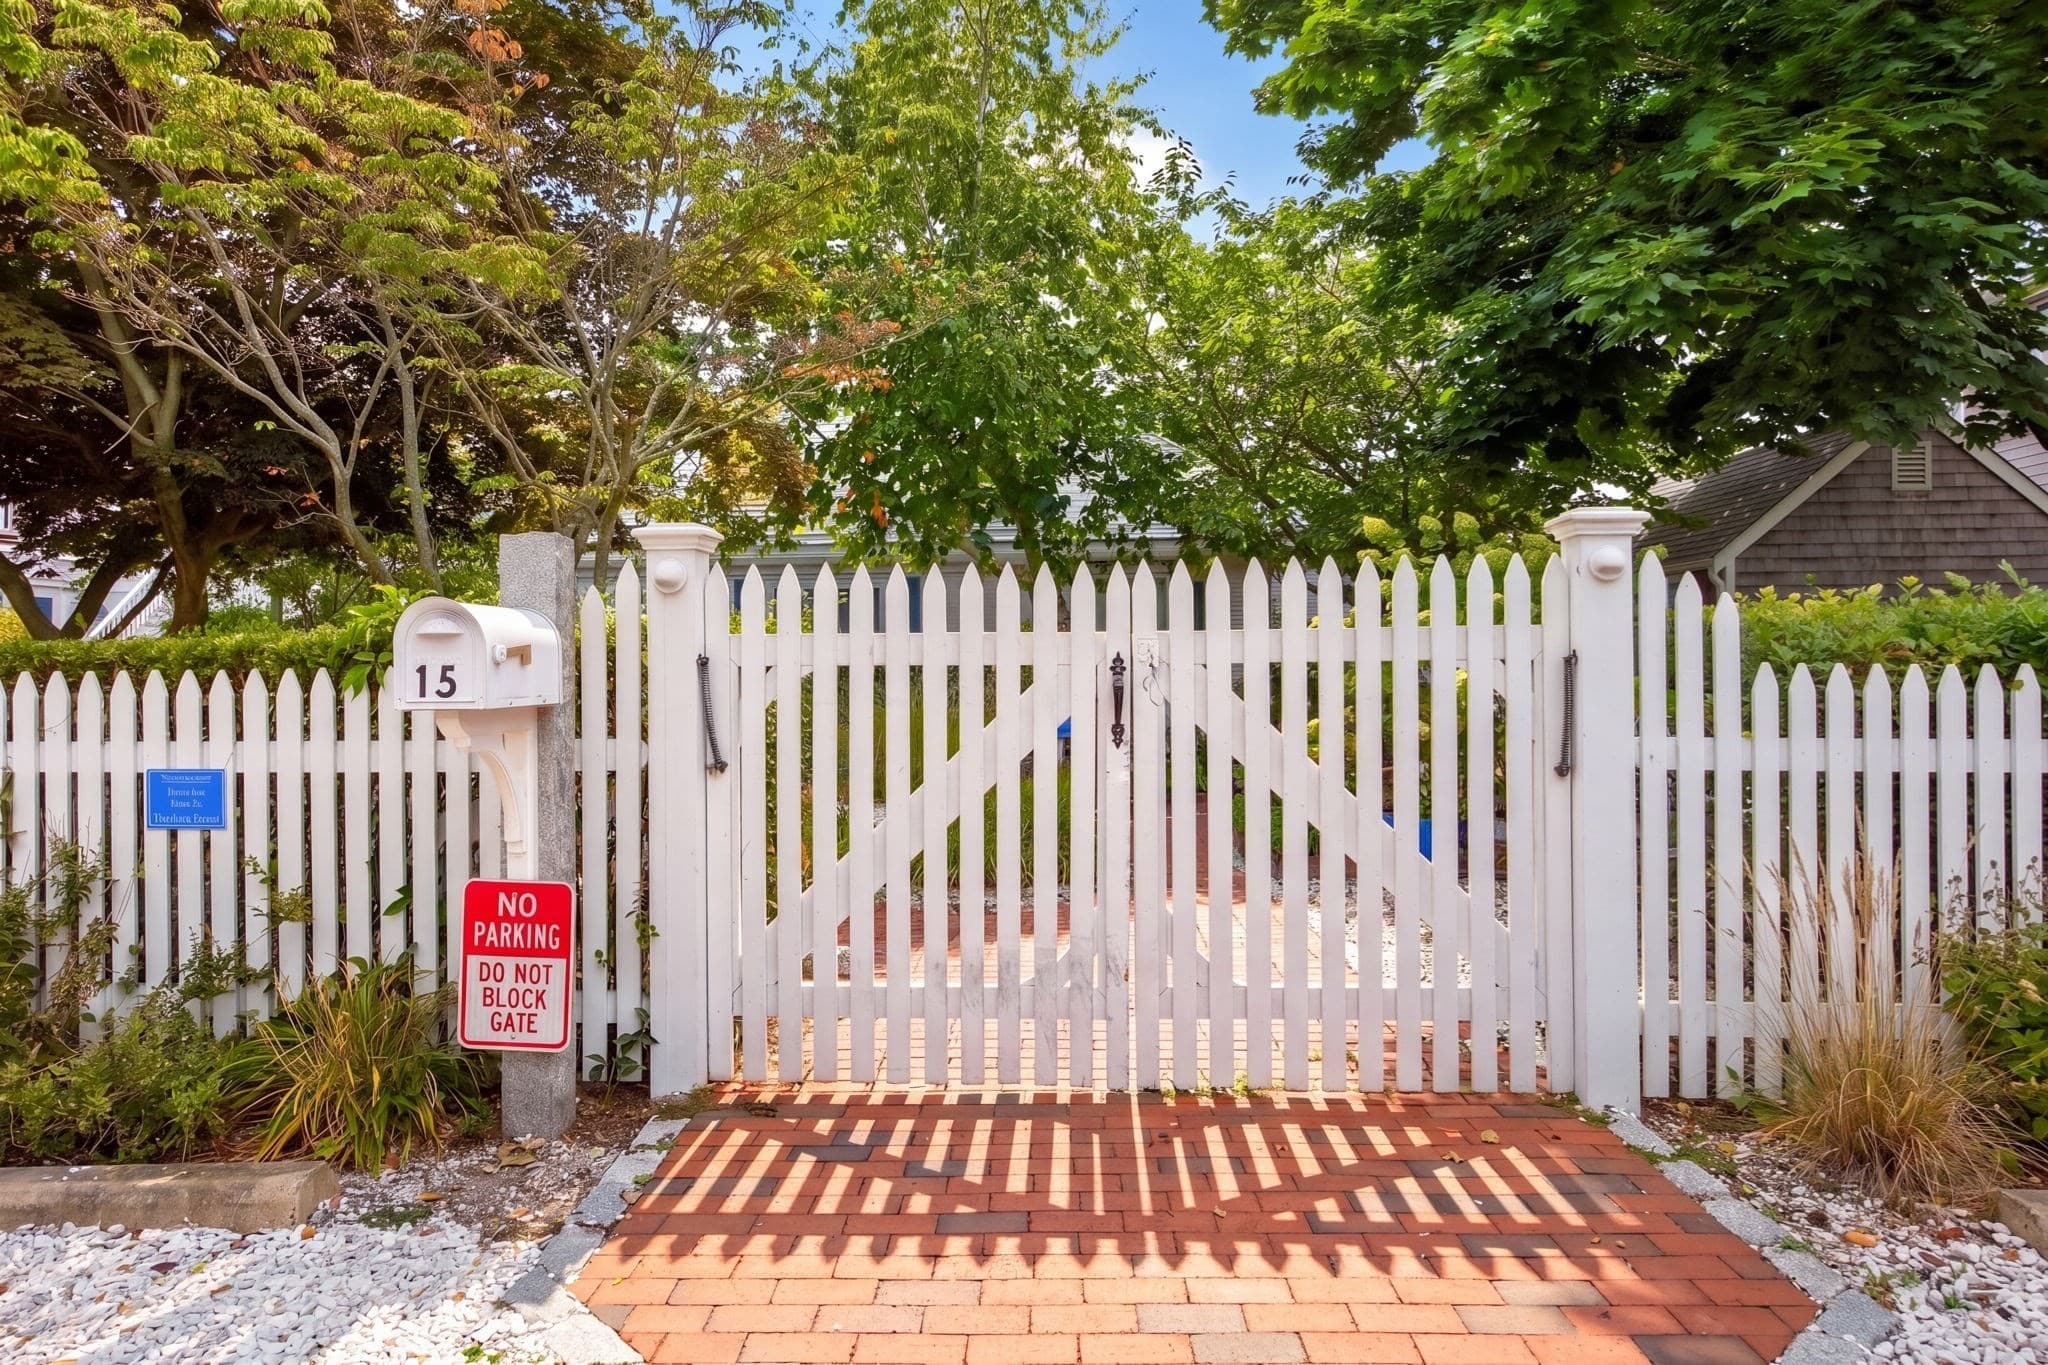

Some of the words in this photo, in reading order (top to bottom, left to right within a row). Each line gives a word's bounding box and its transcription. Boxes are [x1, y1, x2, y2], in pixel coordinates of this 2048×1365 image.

[415, 664, 457, 699] 15
[497, 892, 538, 918] NO
[474, 921, 560, 950] PARKING
[479, 961, 505, 982] DO
[514, 963, 553, 985] NOT
[482, 986, 547, 1010] BLOCK
[490, 1011, 538, 1033] GATE
